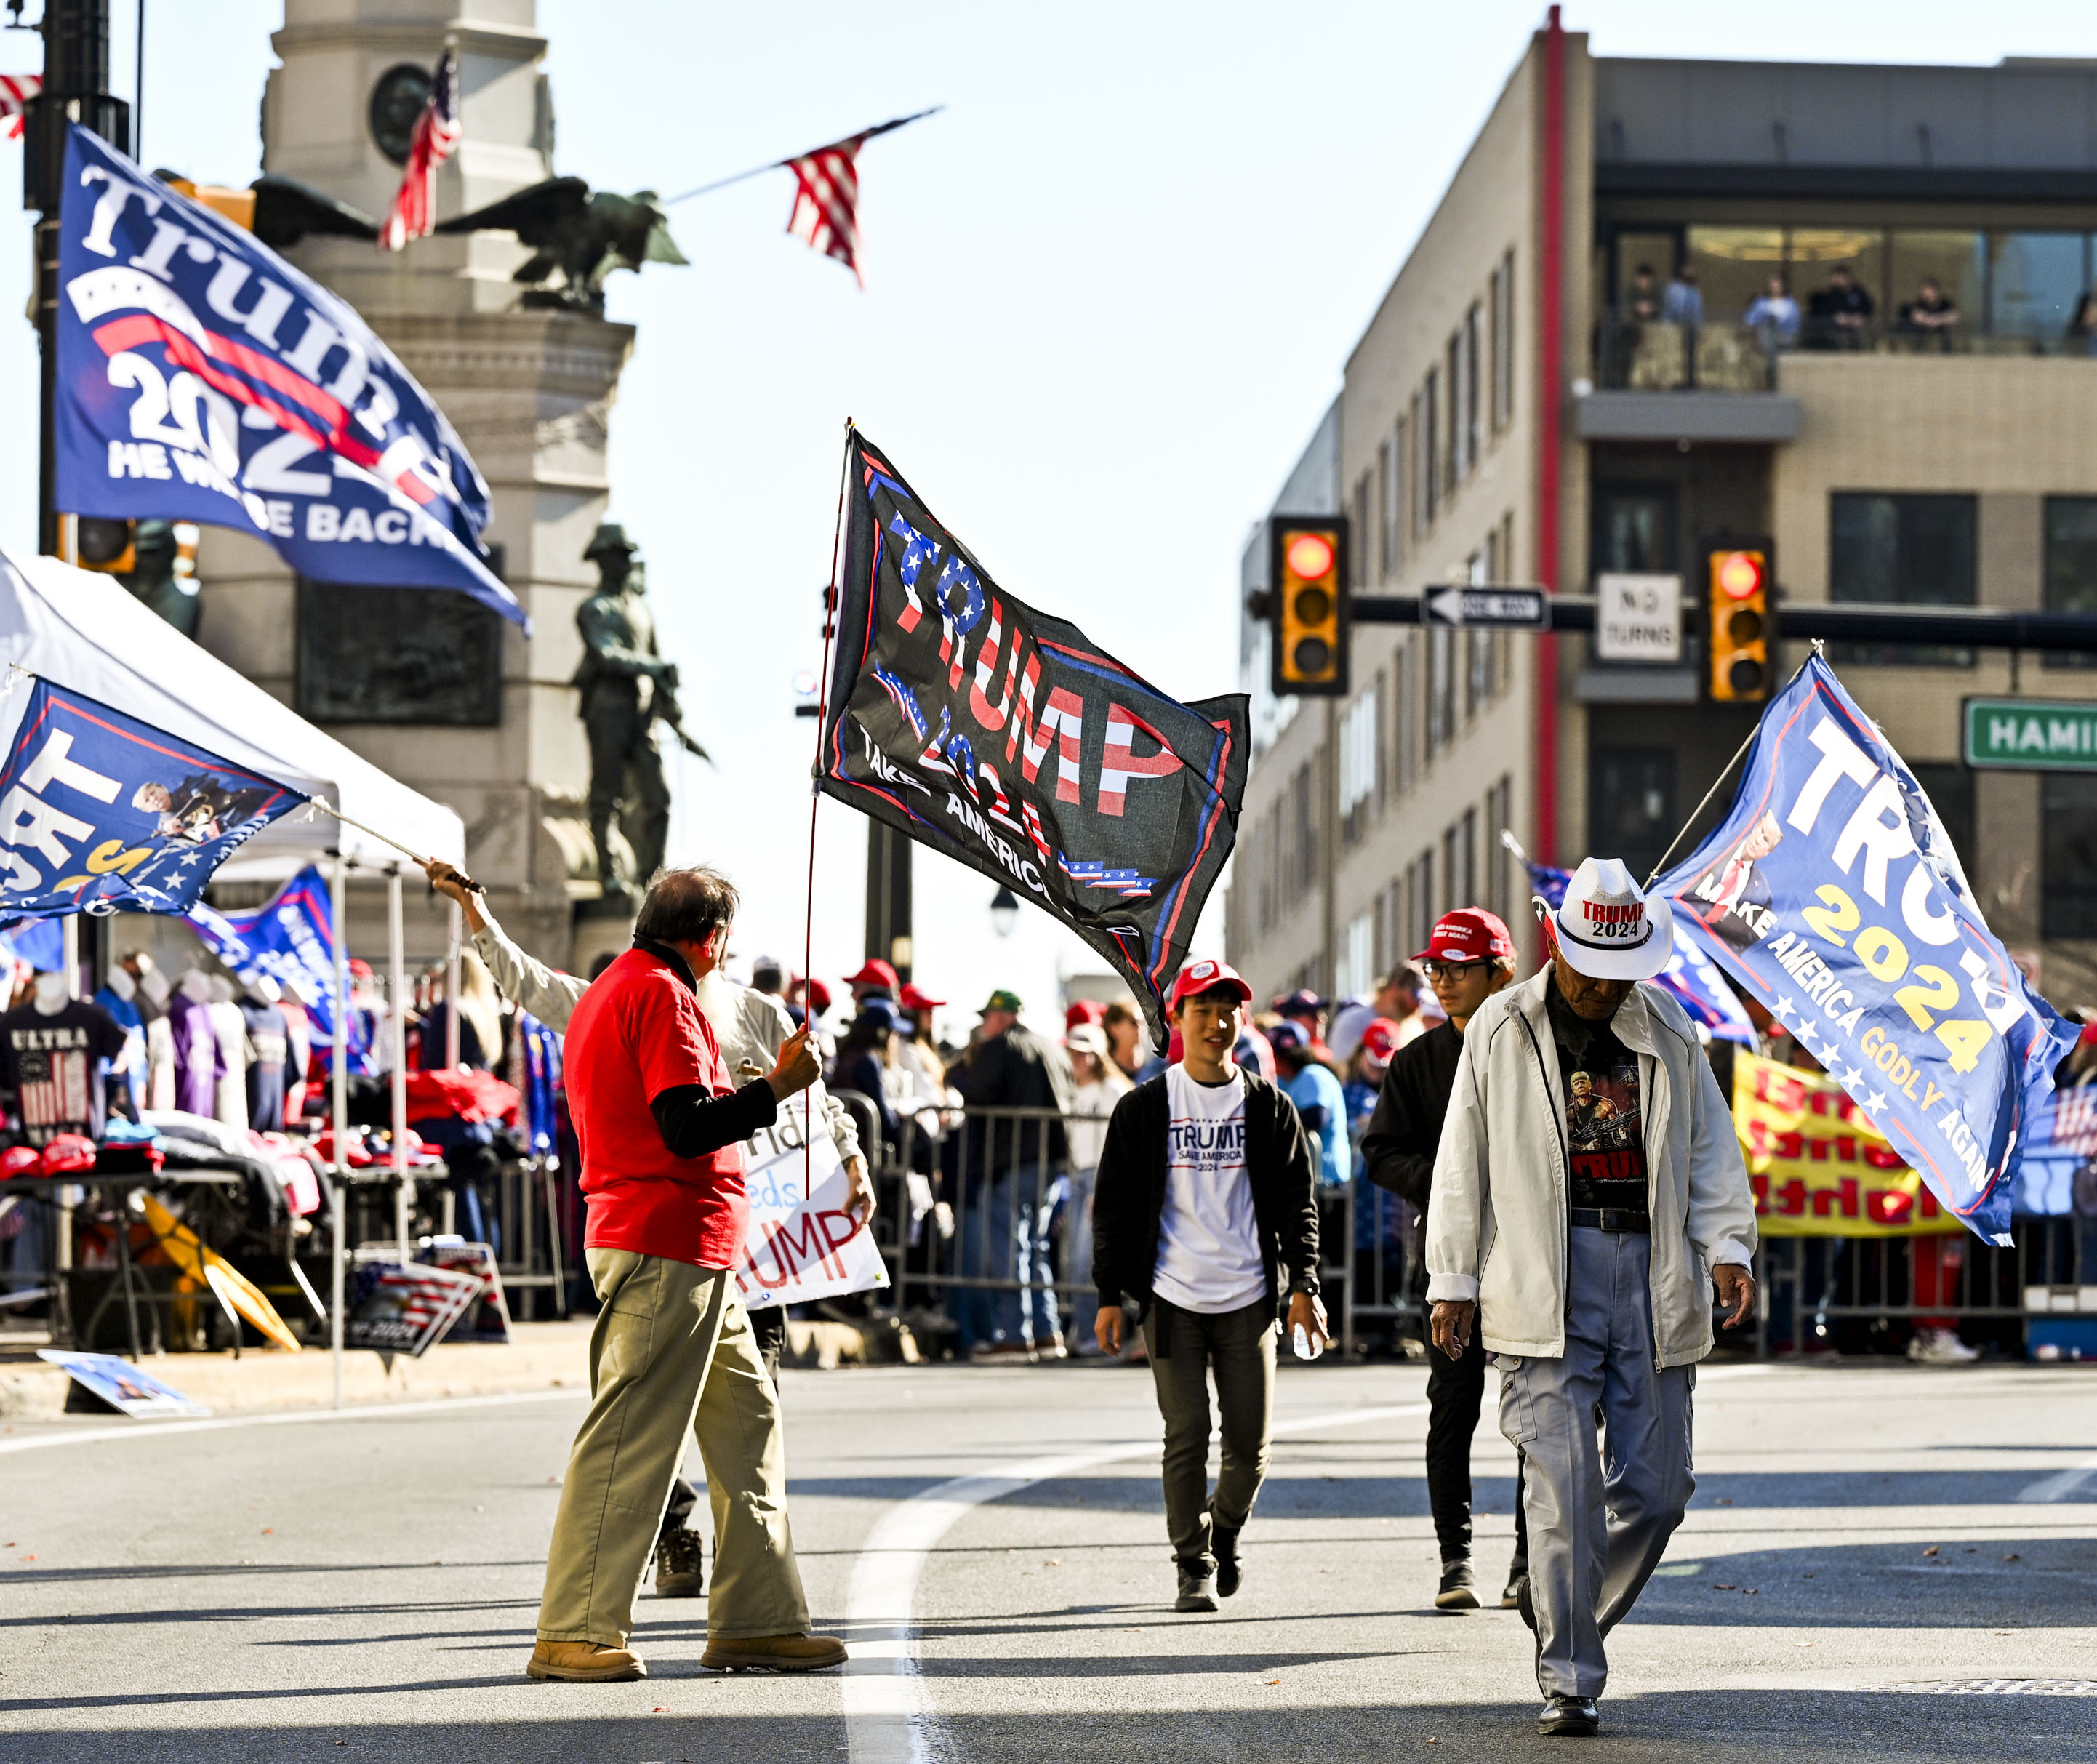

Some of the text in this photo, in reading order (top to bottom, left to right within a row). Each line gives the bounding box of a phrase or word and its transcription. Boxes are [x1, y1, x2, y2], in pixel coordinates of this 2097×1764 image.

[107, 351, 389, 502] 202
[108, 439, 173, 481] HE
[1619, 587, 1659, 615] NO
[1606, 623, 1672, 645] TURNS
[889, 509, 1184, 817] TRUMP
[1989, 715, 2097, 755] HAMI
[859, 724, 1056, 908] TAKE AMERIC
[1787, 716, 2029, 1037] TRUP
[1582, 900, 1645, 923] TRUMP
[1592, 921, 1639, 938] 2024
[1800, 883, 1994, 1075] 2024
[11, 1027, 89, 1051] ULTRA
[1694, 873, 1778, 939] MAKE
[1768, 931, 1867, 1038] AMERICA
[1860, 1026, 1945, 1112] GODLY
[1937, 1109, 1995, 1192] AGAIN
[747, 1104, 806, 1157] rld
[1179, 1150, 1243, 1161] SAVE AMERICA
[745, 1168, 798, 1209] eds
[737, 1210, 858, 1289] UMP
